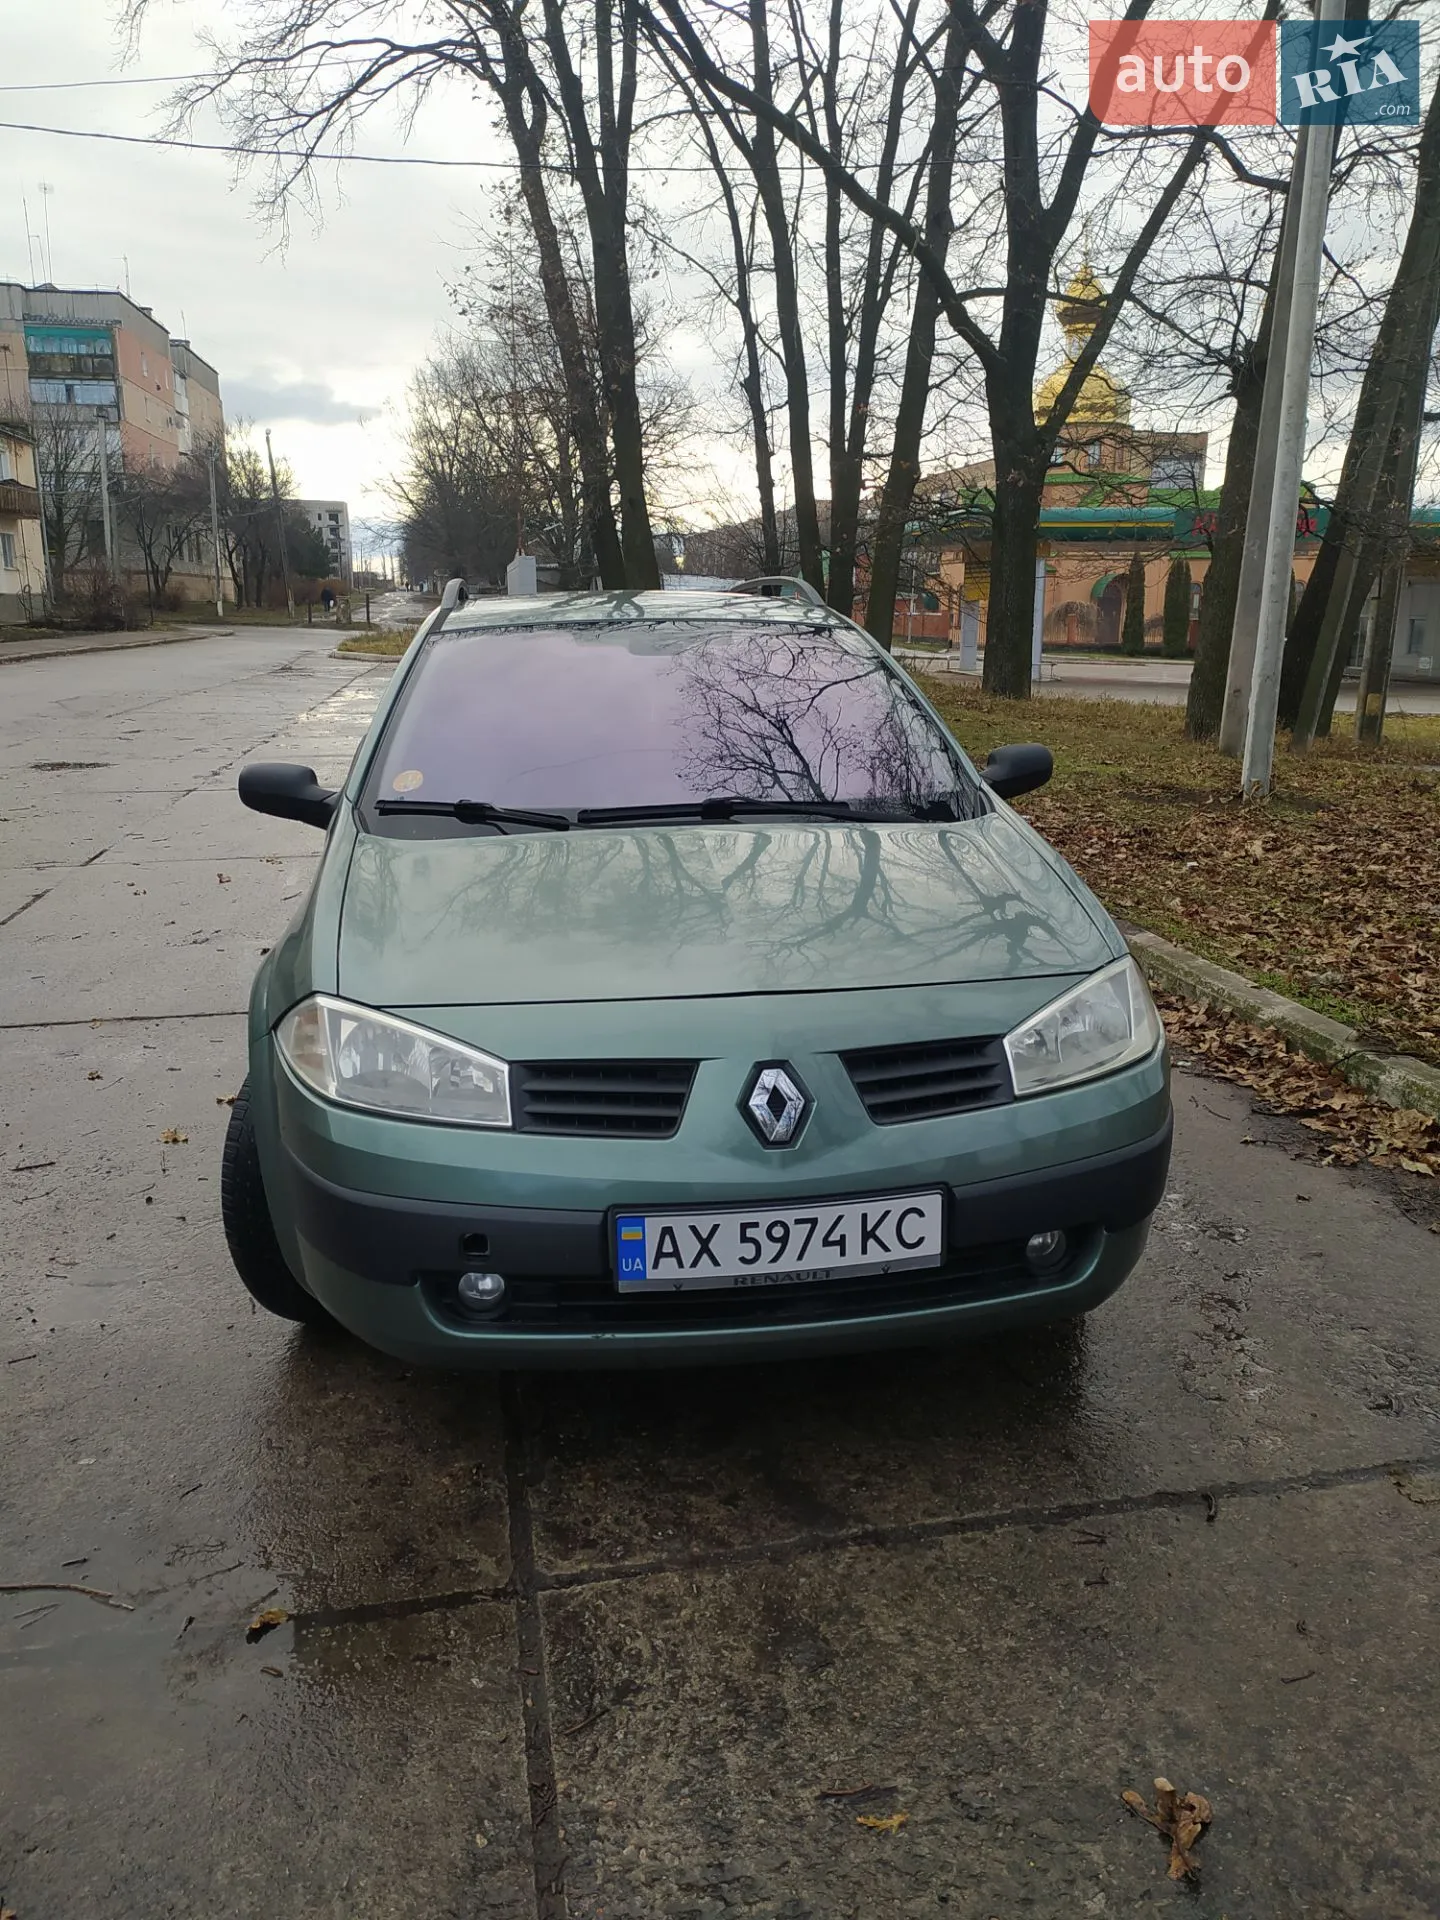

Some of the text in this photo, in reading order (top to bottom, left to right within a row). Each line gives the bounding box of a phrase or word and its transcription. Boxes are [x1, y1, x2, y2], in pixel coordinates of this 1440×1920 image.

[652, 1207, 926, 1271] AX 5974 KC
[622, 1257, 644, 1273] UA
[733, 1269, 833, 1286] RENAULT
